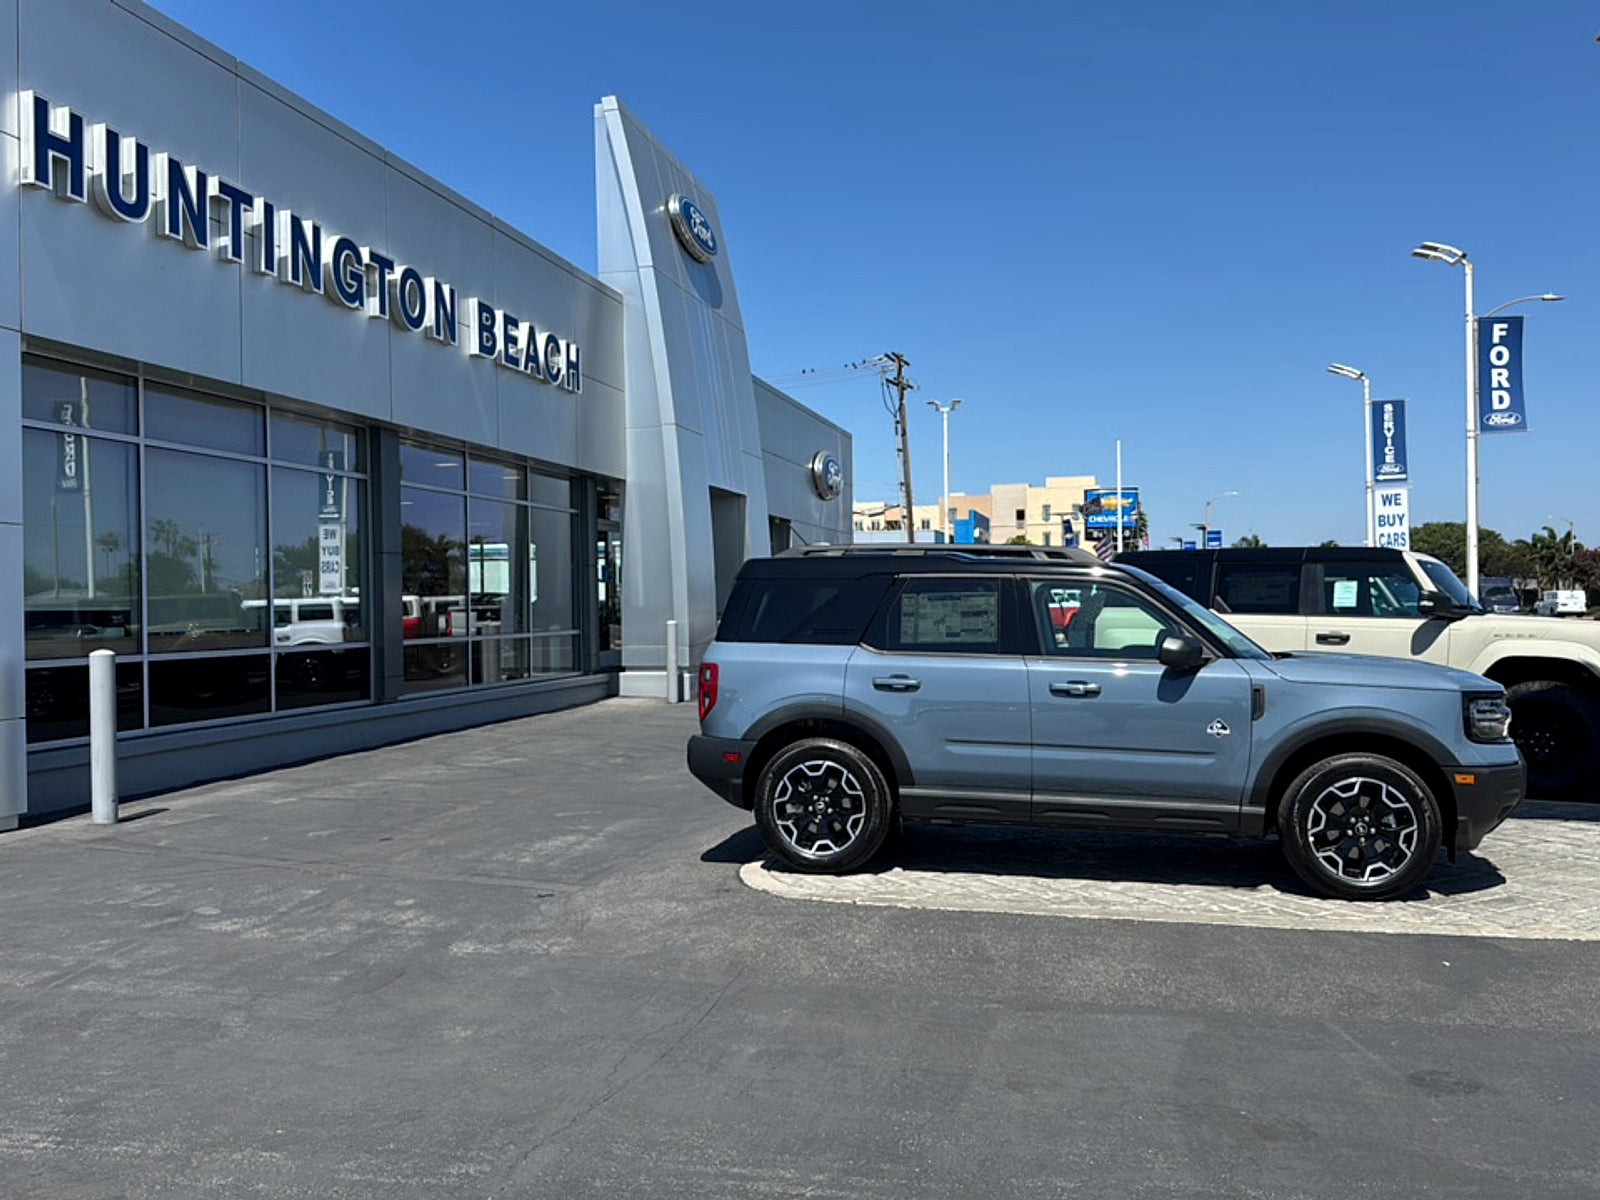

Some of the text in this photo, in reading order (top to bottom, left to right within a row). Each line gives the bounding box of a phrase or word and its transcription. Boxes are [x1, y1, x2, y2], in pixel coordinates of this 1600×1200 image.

[20, 90, 583, 394] HUNTINGTON BEACH
[1490, 323, 1511, 410] FORD
[1487, 413, 1518, 426] Ford
[1383, 403, 1396, 463] SERVICE
[1381, 494, 1402, 507] WE
[1378, 514, 1406, 528] BUY
[1378, 532, 1407, 548] CARS
